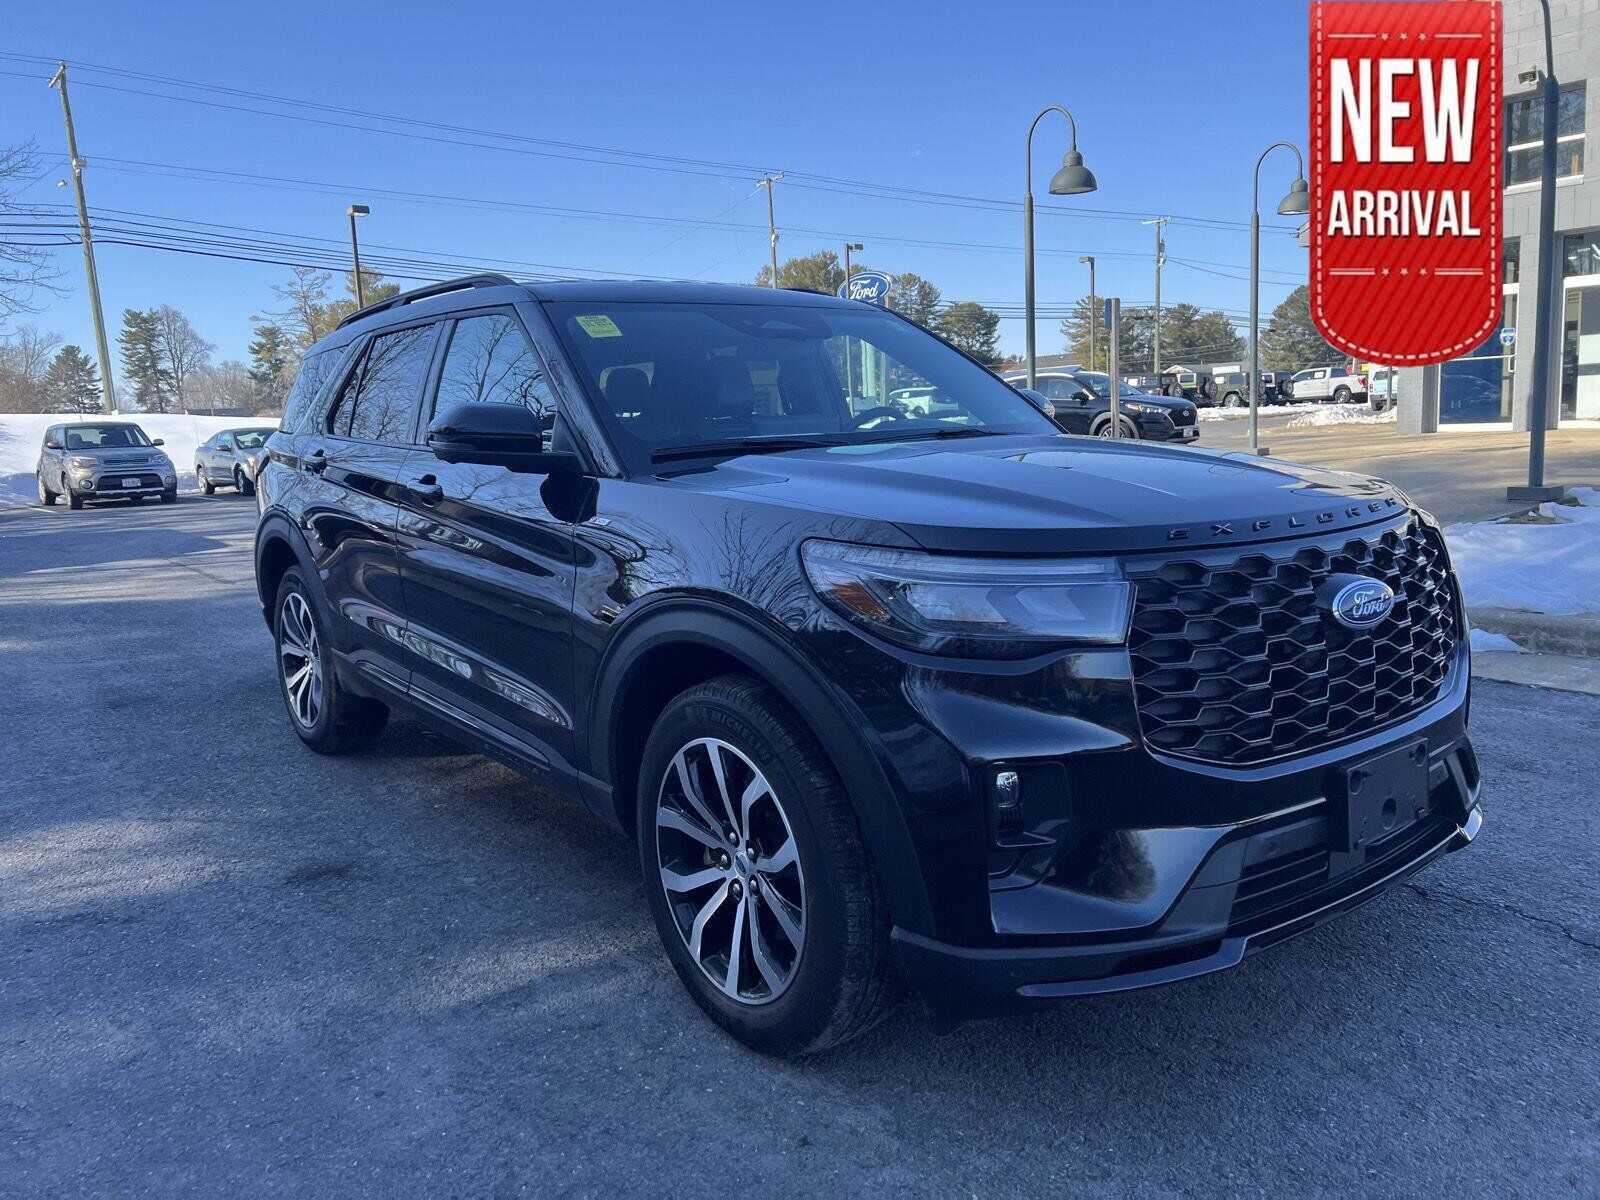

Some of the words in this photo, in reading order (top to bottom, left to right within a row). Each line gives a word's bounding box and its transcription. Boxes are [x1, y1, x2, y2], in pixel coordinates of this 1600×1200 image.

[849, 279, 880, 300] Ford
[1167, 496, 1398, 540] EXPLORER
[1353, 589, 1389, 618] Ford
